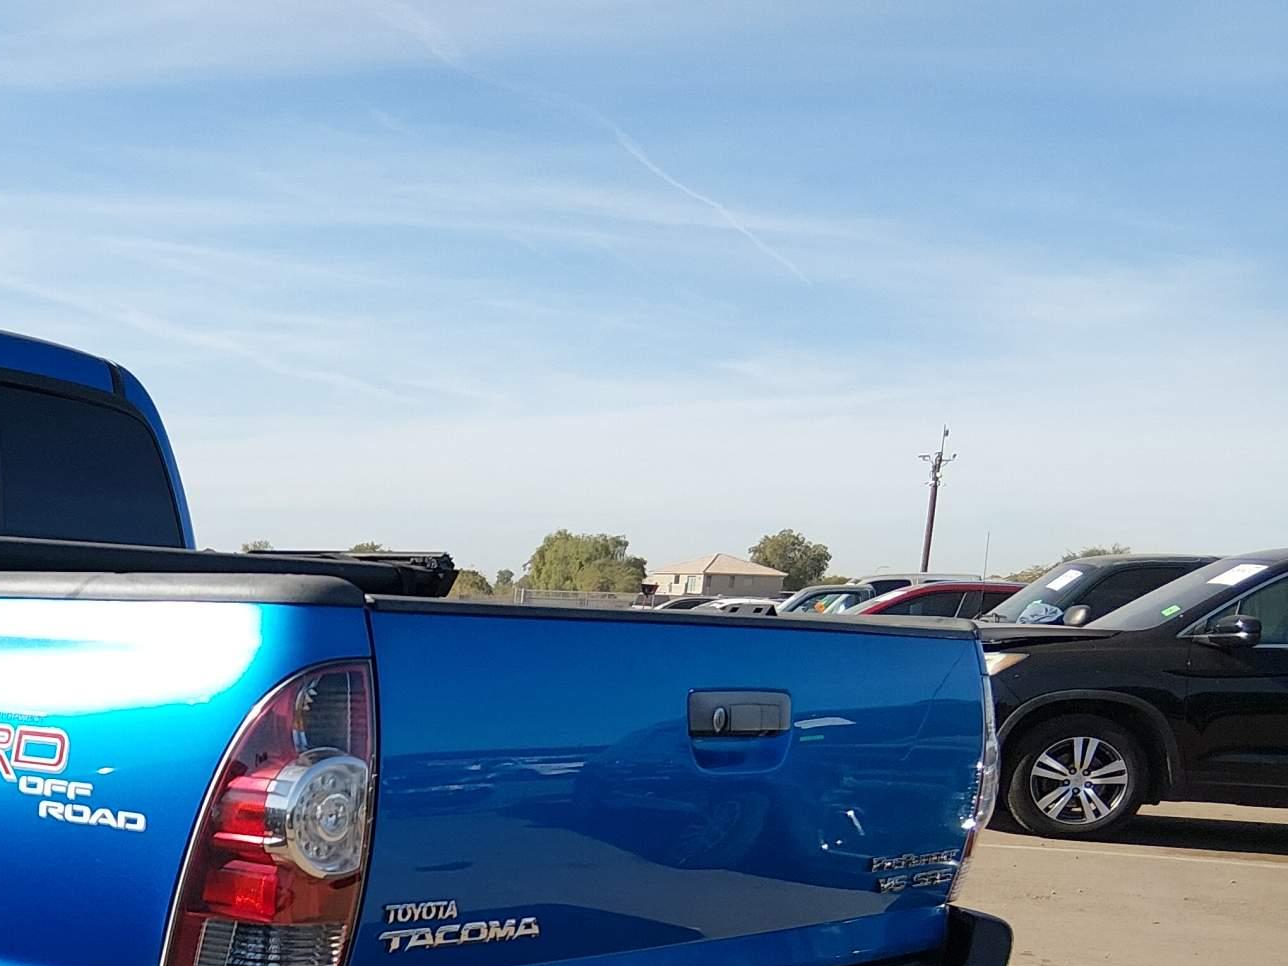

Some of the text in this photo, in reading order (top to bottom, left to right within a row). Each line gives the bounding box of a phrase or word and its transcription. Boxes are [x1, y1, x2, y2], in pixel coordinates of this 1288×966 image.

[18, 775, 94, 800] OFF
[38, 800, 147, 832] ROAD
[385, 900, 458, 924] TOYOTA
[378, 916, 540, 953] TACOMA
